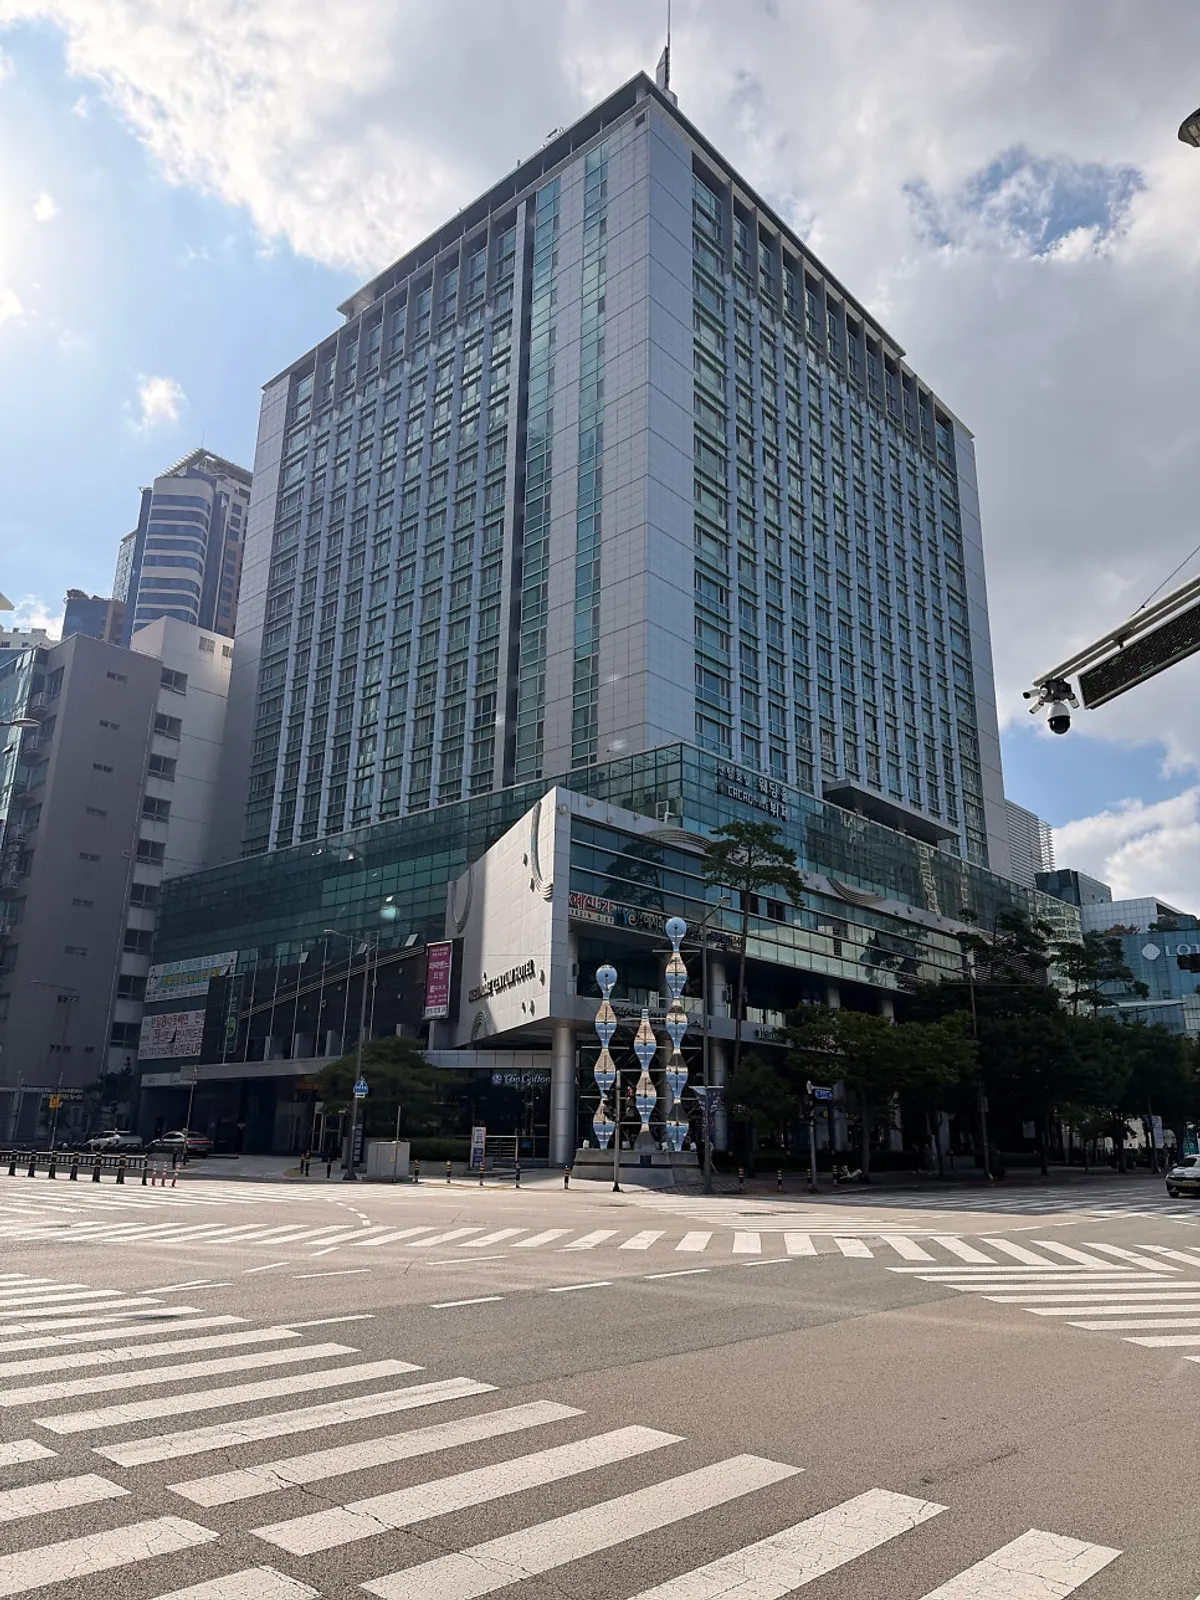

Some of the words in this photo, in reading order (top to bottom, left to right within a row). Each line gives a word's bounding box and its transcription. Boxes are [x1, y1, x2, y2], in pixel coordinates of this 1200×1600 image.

[727, 785, 753, 805] CACAO
[758, 777, 788, 804] 웨딩홀
[503, 1073, 520, 1084] The
[521, 1072, 551, 1085] Coffee
